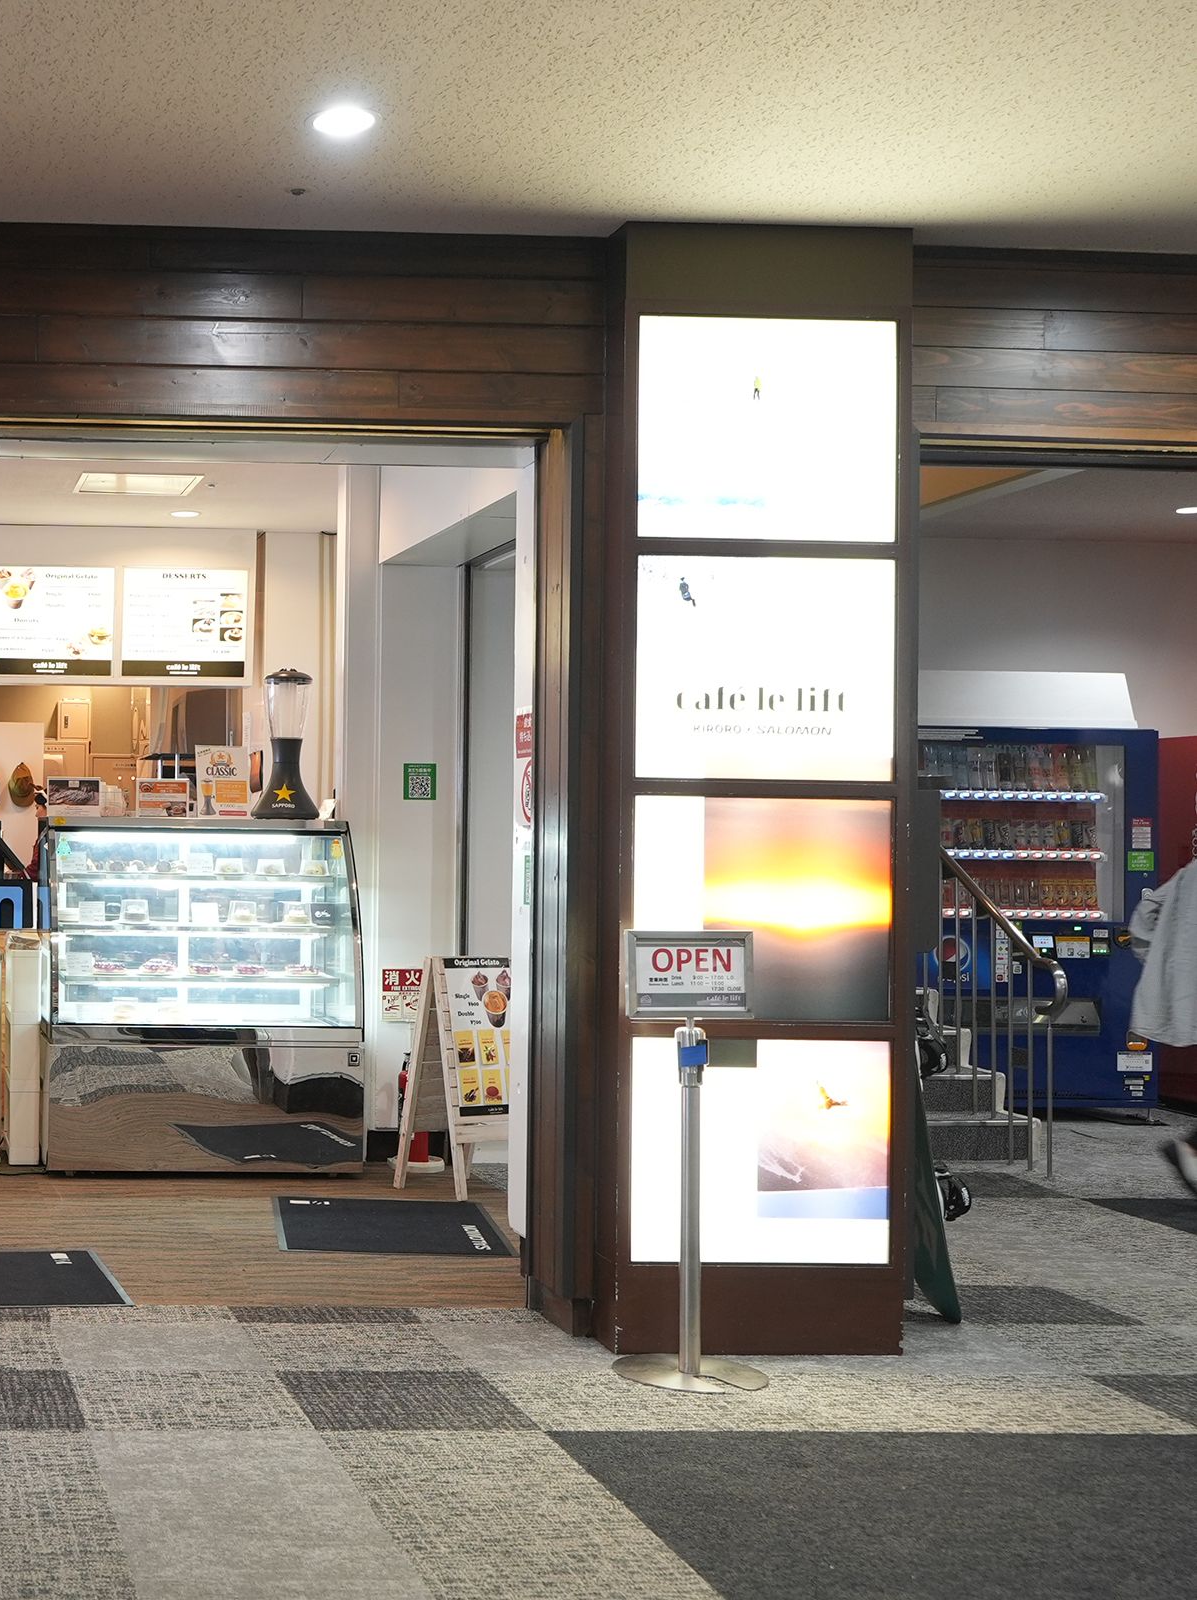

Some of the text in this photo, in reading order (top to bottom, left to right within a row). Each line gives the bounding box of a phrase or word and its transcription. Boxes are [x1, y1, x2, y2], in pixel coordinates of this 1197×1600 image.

[676, 686, 844, 712] café le lift
[693, 724, 742, 734] KIRORO
[757, 726, 832, 736] SALOMON
[206, 766, 237, 776] CLASSIC
[652, 948, 732, 972] OPEN
[462, 1225, 491, 1250] SALOMON
